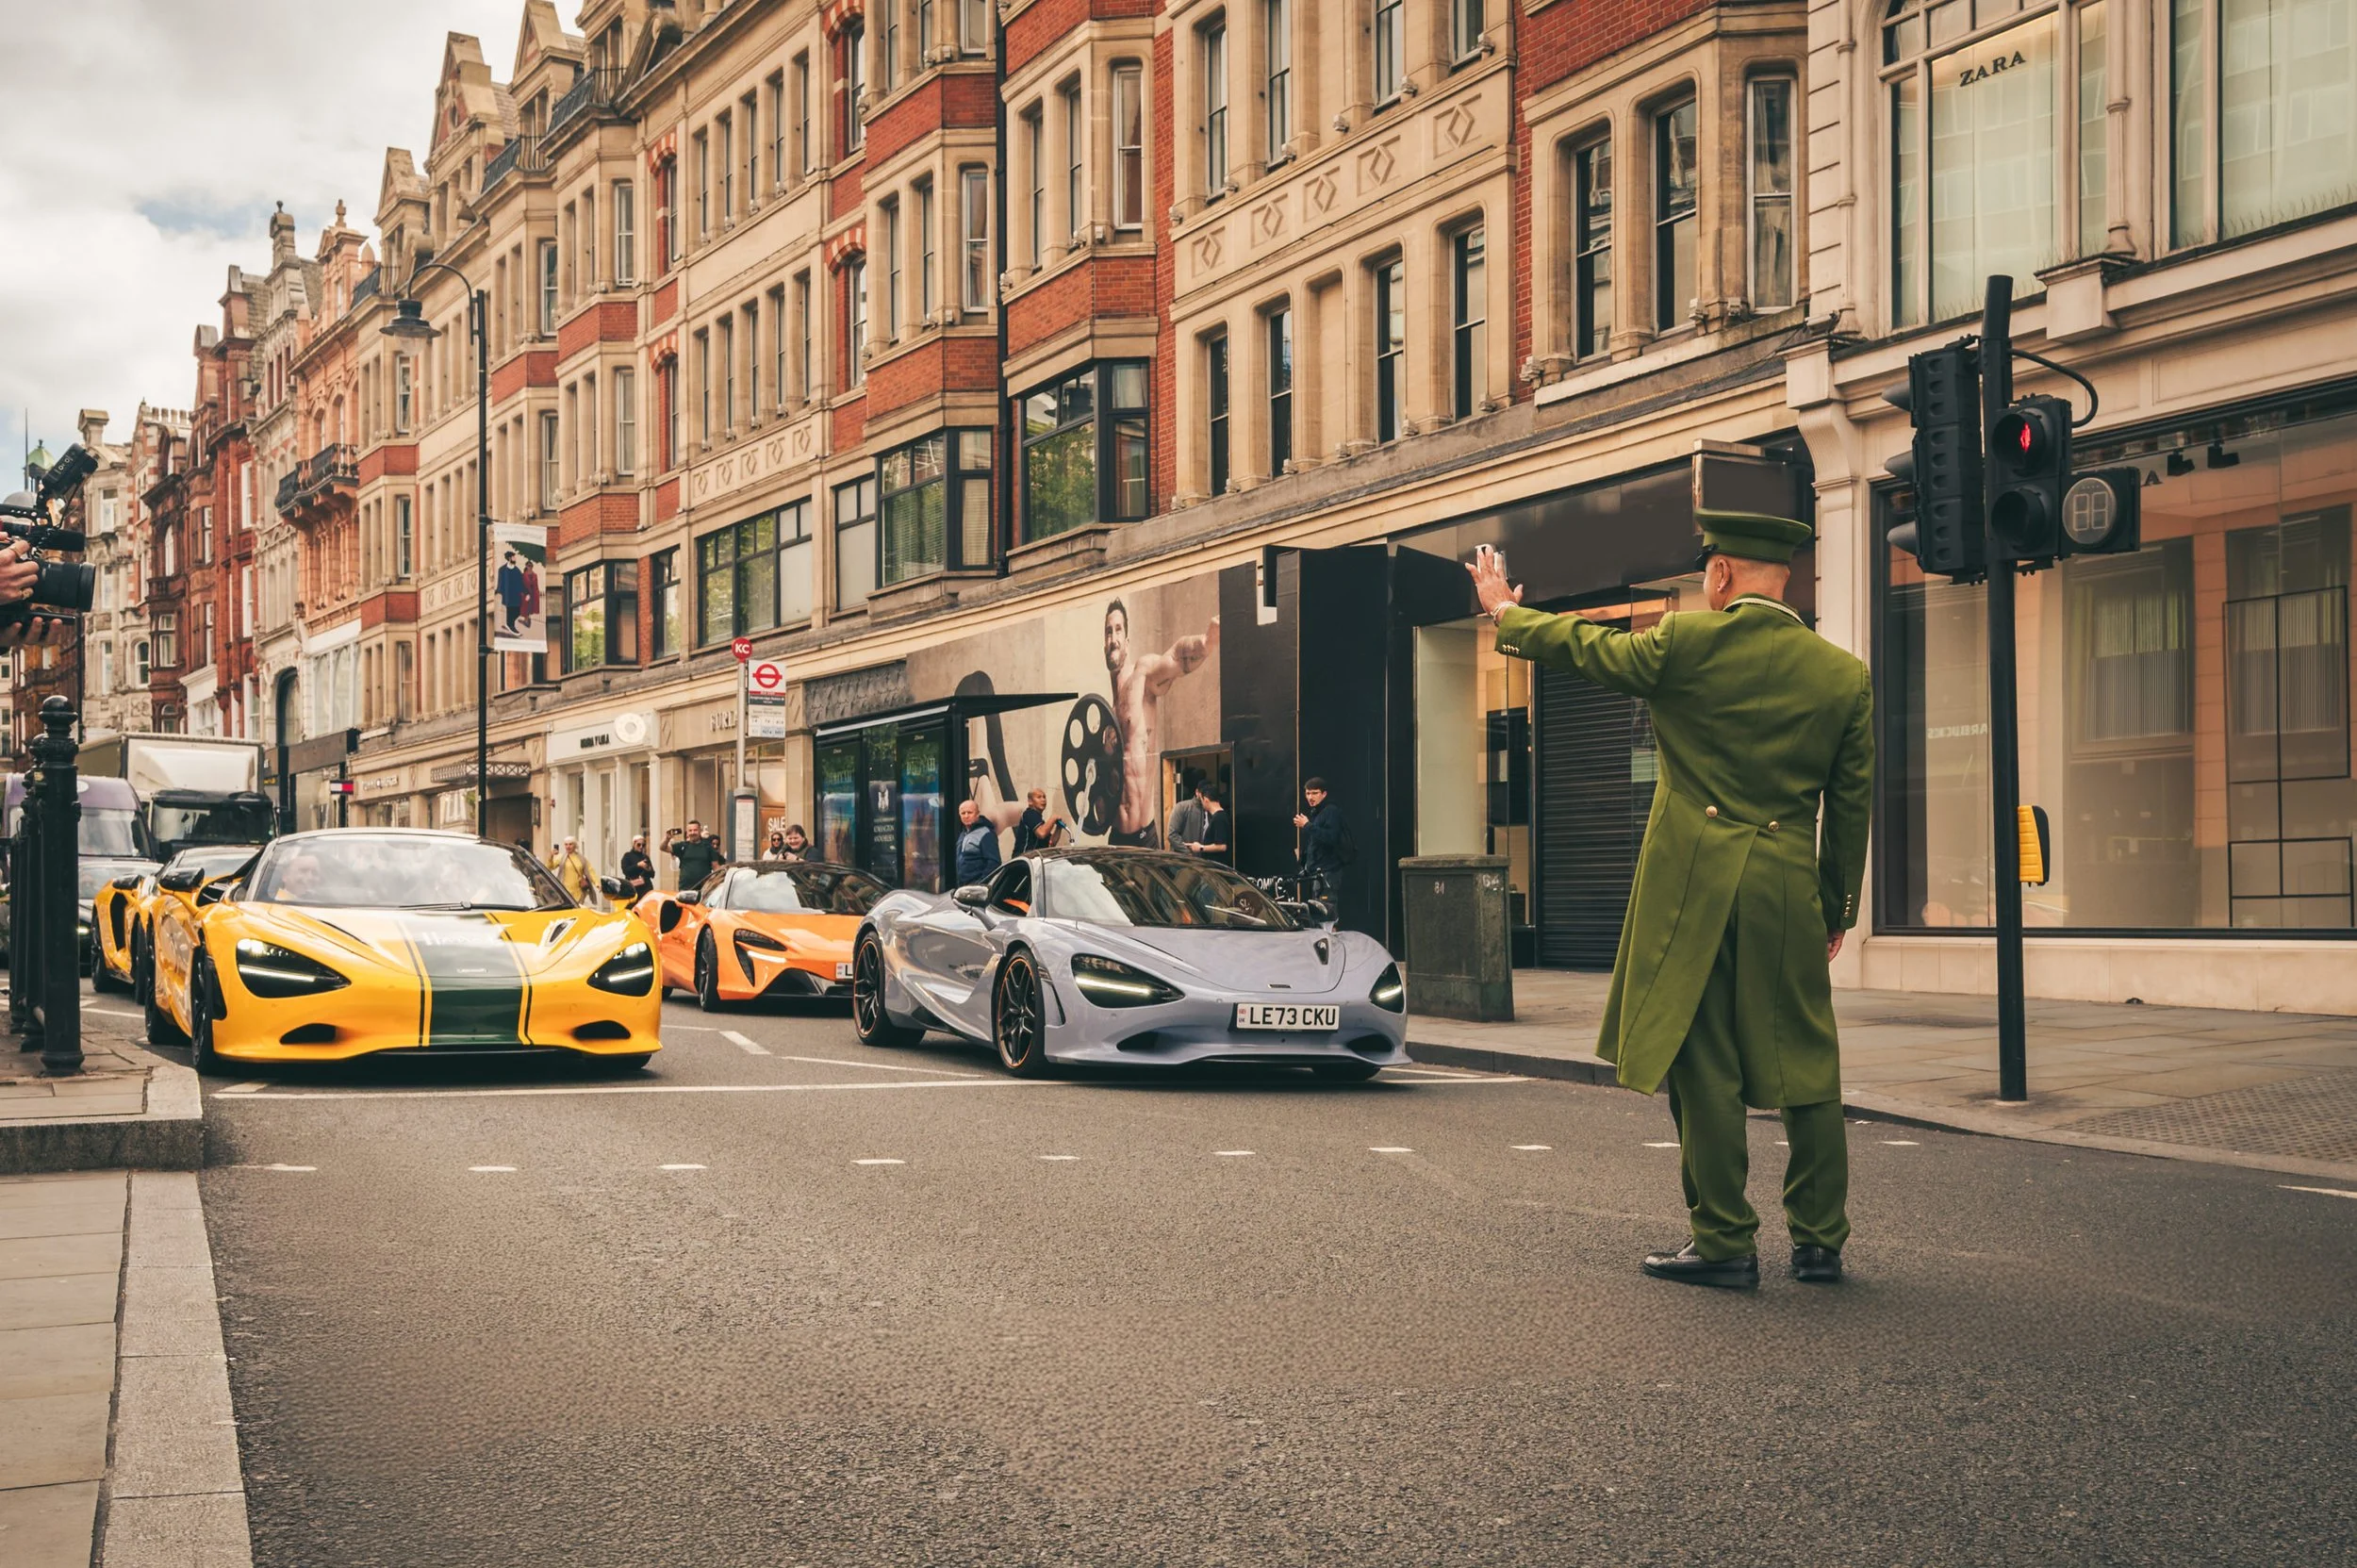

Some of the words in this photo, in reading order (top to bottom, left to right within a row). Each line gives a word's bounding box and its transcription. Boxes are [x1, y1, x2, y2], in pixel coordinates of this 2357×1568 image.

[1960, 50, 2026, 87] ZARA
[735, 643, 750, 653] KC
[711, 710, 737, 732] FURL
[768, 817, 786, 832] SALE
[1249, 1006, 1297, 1025] LE73
[1302, 1008, 1336, 1026] CKU
